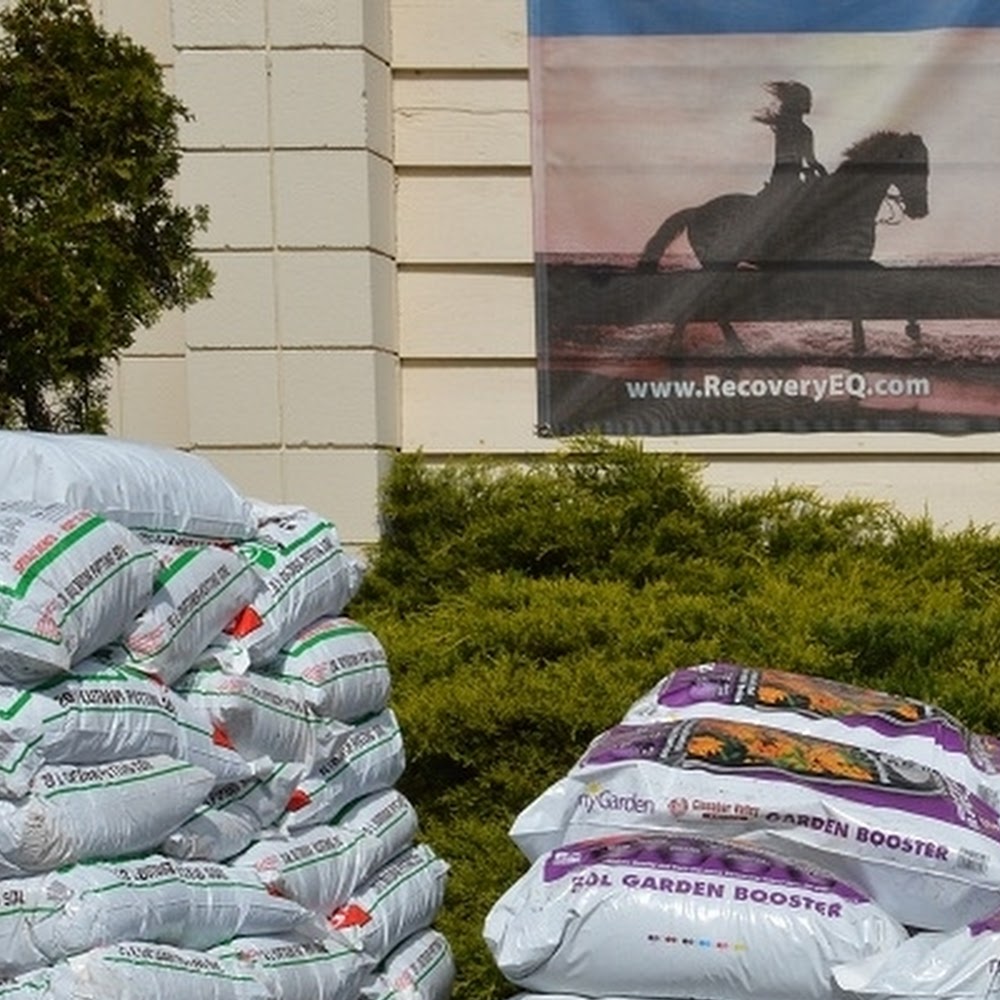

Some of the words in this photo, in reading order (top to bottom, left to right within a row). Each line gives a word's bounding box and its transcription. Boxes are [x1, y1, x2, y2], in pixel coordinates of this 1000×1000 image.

[625, 373, 931, 403] www.RecoveryEQ.com
[765, 811, 850, 839] GARDEN
[856, 826, 950, 862] BOOSTER
[622, 874, 726, 899] GARDEN
[734, 888, 844, 918] BOOSTER
